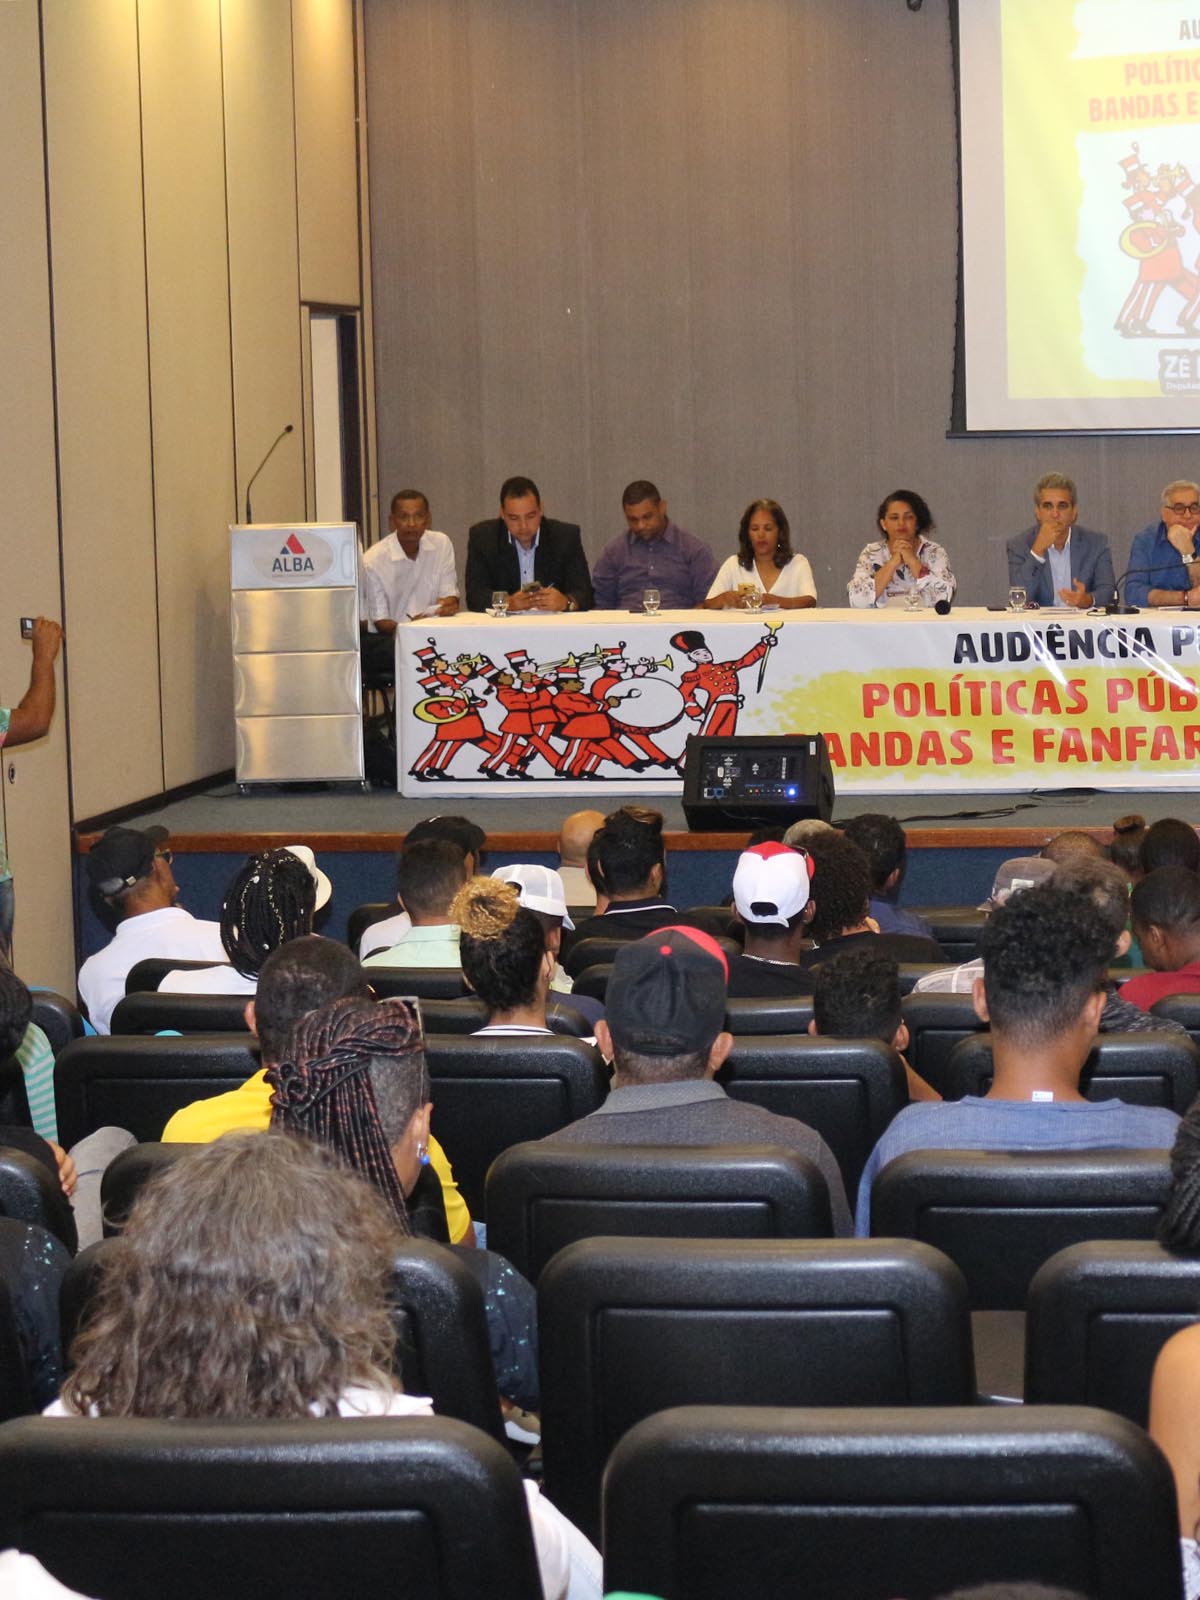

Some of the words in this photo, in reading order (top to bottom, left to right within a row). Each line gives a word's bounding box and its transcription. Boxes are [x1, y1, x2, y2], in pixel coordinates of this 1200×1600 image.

[1088, 94, 1180, 123] BANDAS
[1186, 91, 1199, 117] E
[1164, 353, 1191, 379] ZÉ
[272, 557, 314, 572] ALBA
[953, 622, 1156, 665] AUDIÊNCIA
[862, 673, 1088, 718] POLÍTICAS
[784, 730, 974, 767] ANDAS
[991, 729, 1015, 764] E
